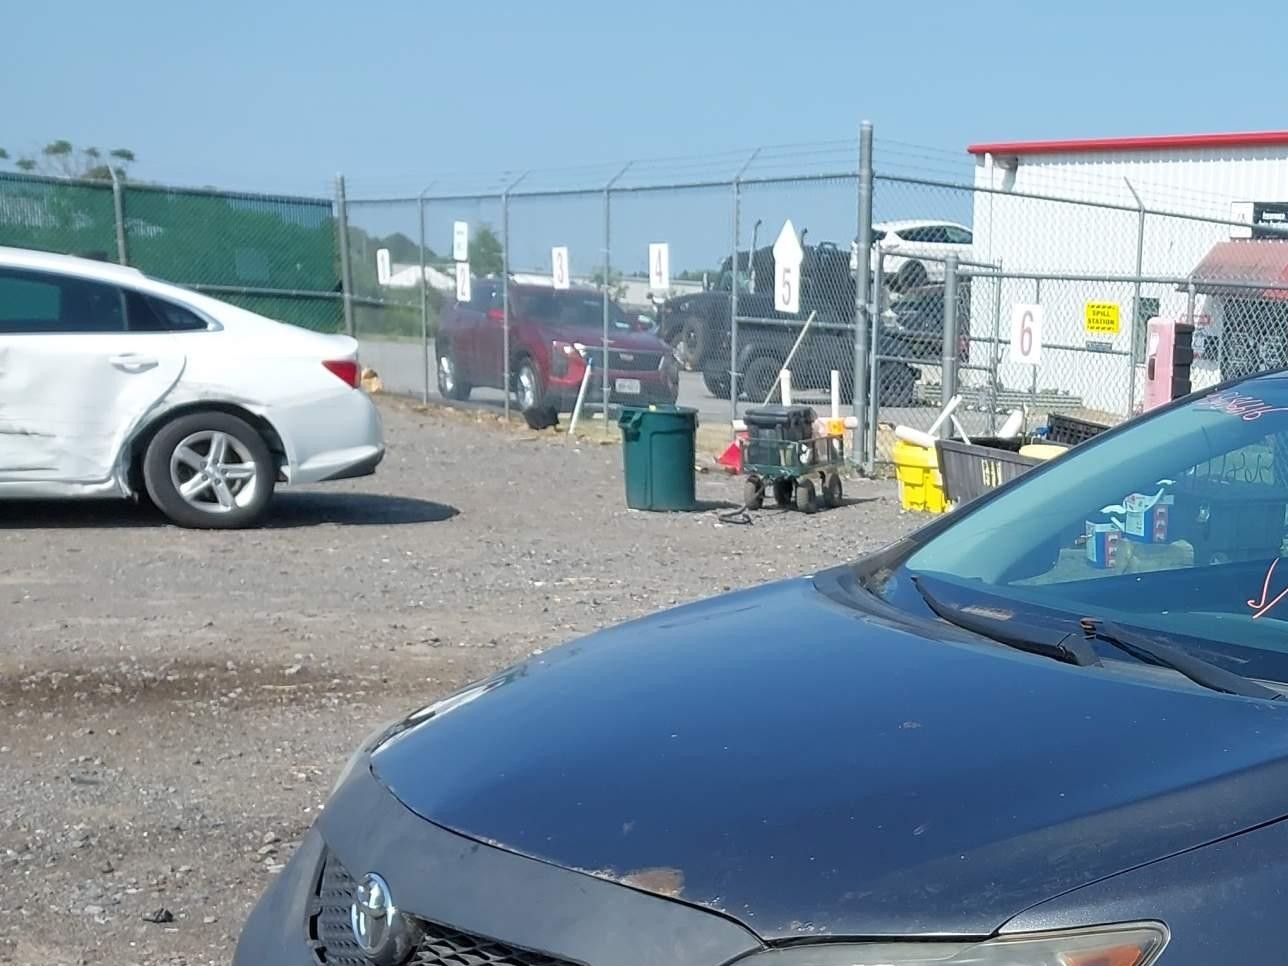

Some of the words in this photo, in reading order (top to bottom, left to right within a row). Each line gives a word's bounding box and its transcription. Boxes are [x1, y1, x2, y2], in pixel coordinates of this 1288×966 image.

[556, 251, 565, 284] 3
[655, 248, 663, 284] 4
[782, 267, 792, 306] 5
[1092, 309, 1111, 317] SPILL
[1020, 309, 1034, 357] 6
